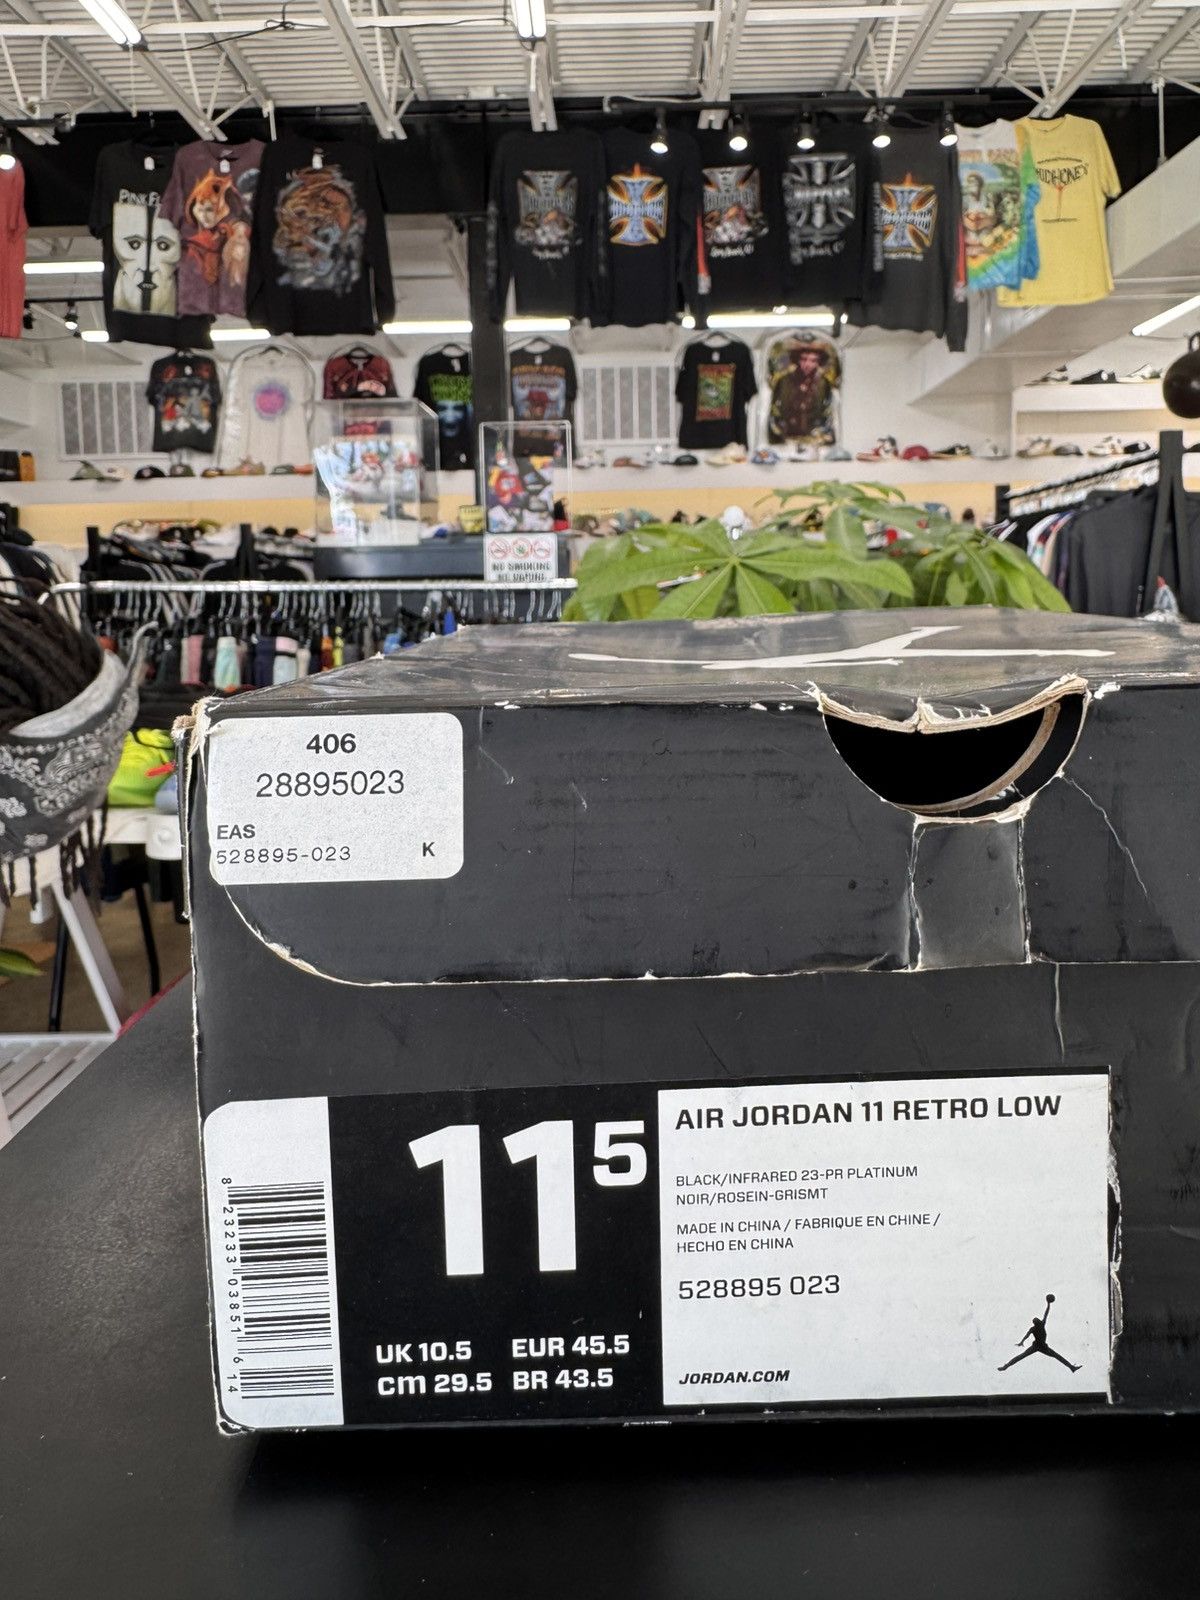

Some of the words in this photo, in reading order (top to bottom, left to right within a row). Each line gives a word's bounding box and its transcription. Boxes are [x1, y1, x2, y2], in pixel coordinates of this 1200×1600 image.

[306, 733, 357, 755] 406
[256, 770, 405, 798] 28895023
[216, 824, 256, 840] EAS
[216, 846, 351, 865] 528895-023
[422, 842, 436, 857] K
[675, 1108, 724, 1130] AIR
[732, 1102, 853, 1128] JORDAN
[860, 1101, 883, 1122] 11
[893, 1097, 989, 1121] RETRO
[997, 1095, 1062, 1118] LOW
[221, 1177, 232, 1185] 8
[676, 1170, 798, 1187] BLACK/INFRARED
[801, 1168, 844, 1181] 23-PR
[847, 1165, 918, 1180] PLATINUM
[676, 1187, 829, 1206] NOIR/ROSEIN-GRISMT
[222, 1206, 236, 1264] 23233
[677, 1222, 717, 1235] MADE
[720, 1221, 734, 1233] IN
[737, 1219, 781, 1233] CHINA
[795, 1215, 863, 1230] FABRIQUE
[866, 1215, 885, 1227] EN
[888, 1213, 931, 1226] CHINE
[676, 1240, 725, 1254] HECHO
[728, 1239, 747, 1251] EN
[750, 1237, 794, 1251] CHINA
[678, 1277, 782, 1300] 528895
[789, 1274, 840, 1296] 023
[227, 1278, 242, 1335] 03851
[376, 1343, 413, 1364] UK
[418, 1340, 472, 1362] 10.5
[511, 1337, 565, 1358] EUR
[571, 1334, 630, 1356] 45.5
[233, 1356, 243, 1364] 6
[434, 1372, 493, 1394] 29.5
[512, 1370, 548, 1391] BR
[554, 1367, 614, 1389] 43.5
[678, 1369, 791, 1386] JORDAN.COM
